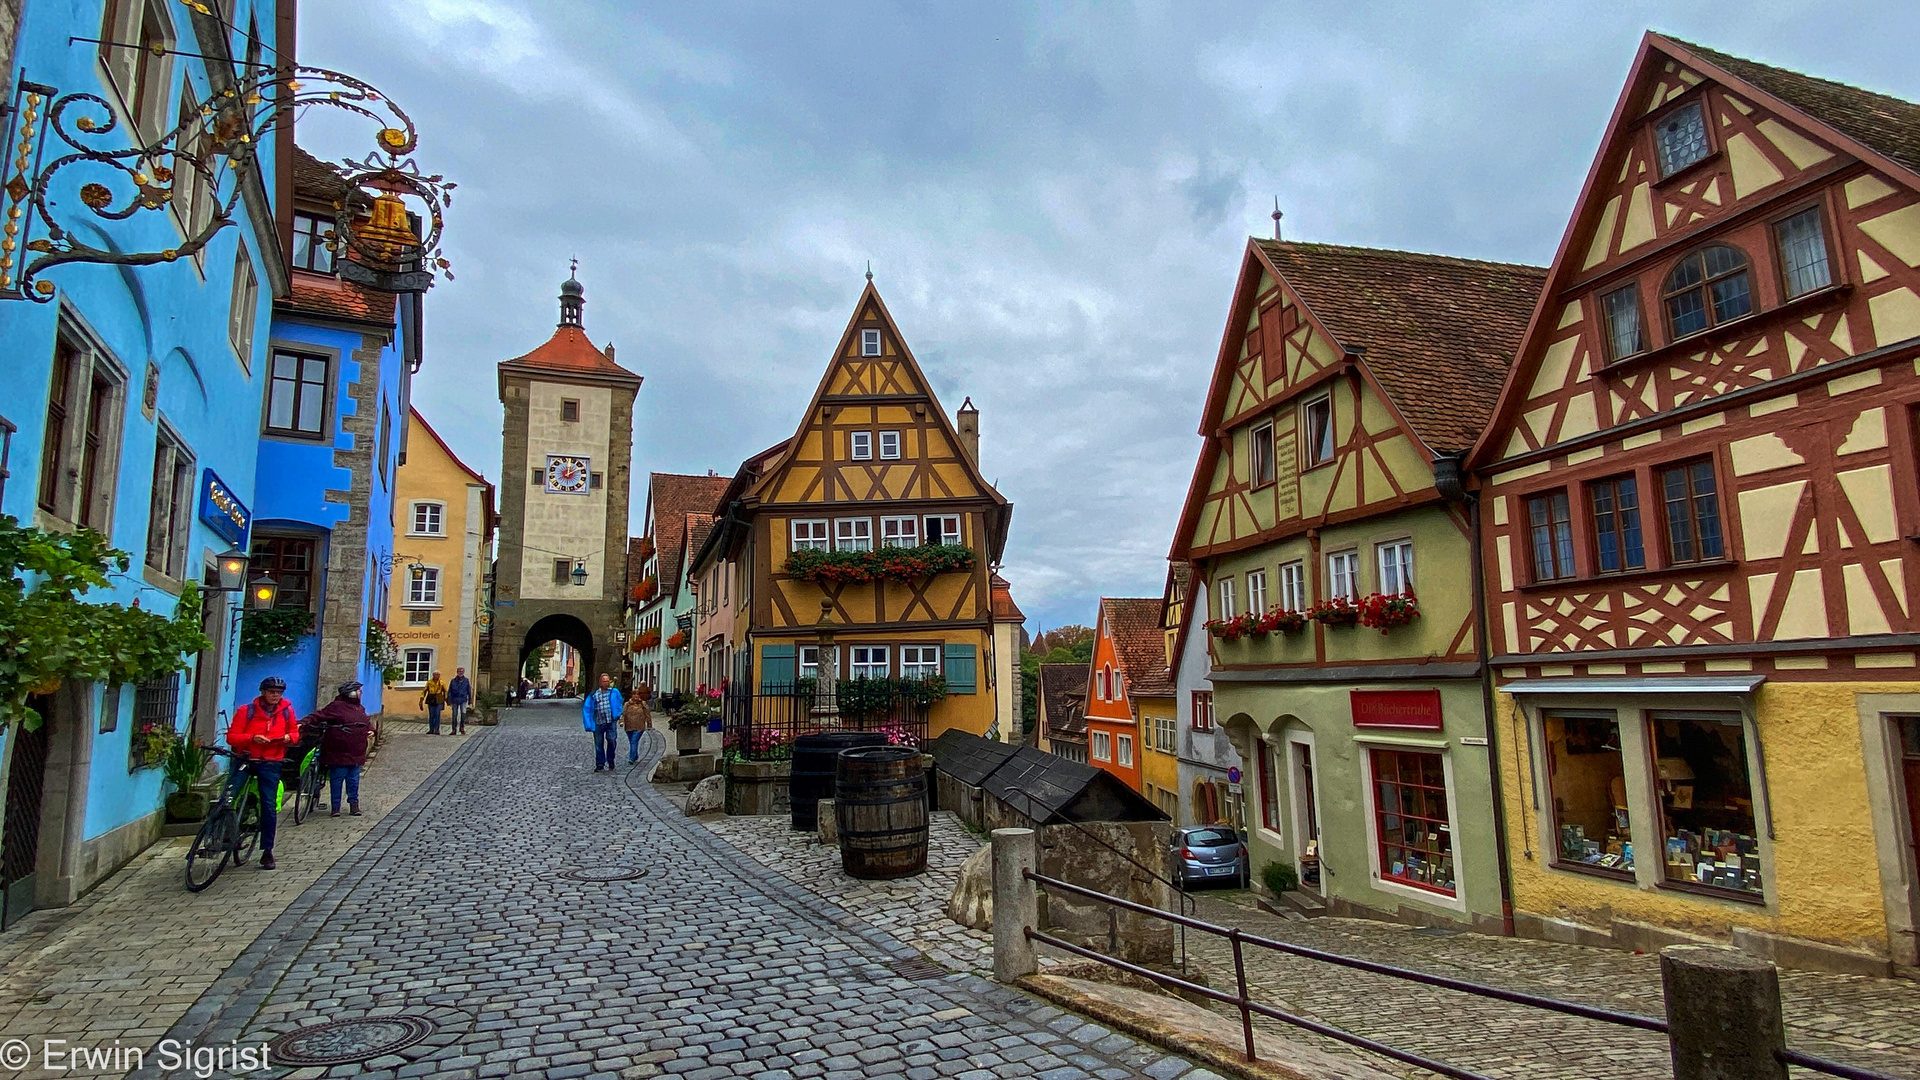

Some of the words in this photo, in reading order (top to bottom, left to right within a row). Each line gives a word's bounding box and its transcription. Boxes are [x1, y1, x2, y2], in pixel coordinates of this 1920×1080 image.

[345, 264, 425, 288] GASTHOF
[389, 631, 441, 640] ocolaterie
[1378, 702, 1432, 716] Büchertruhe
